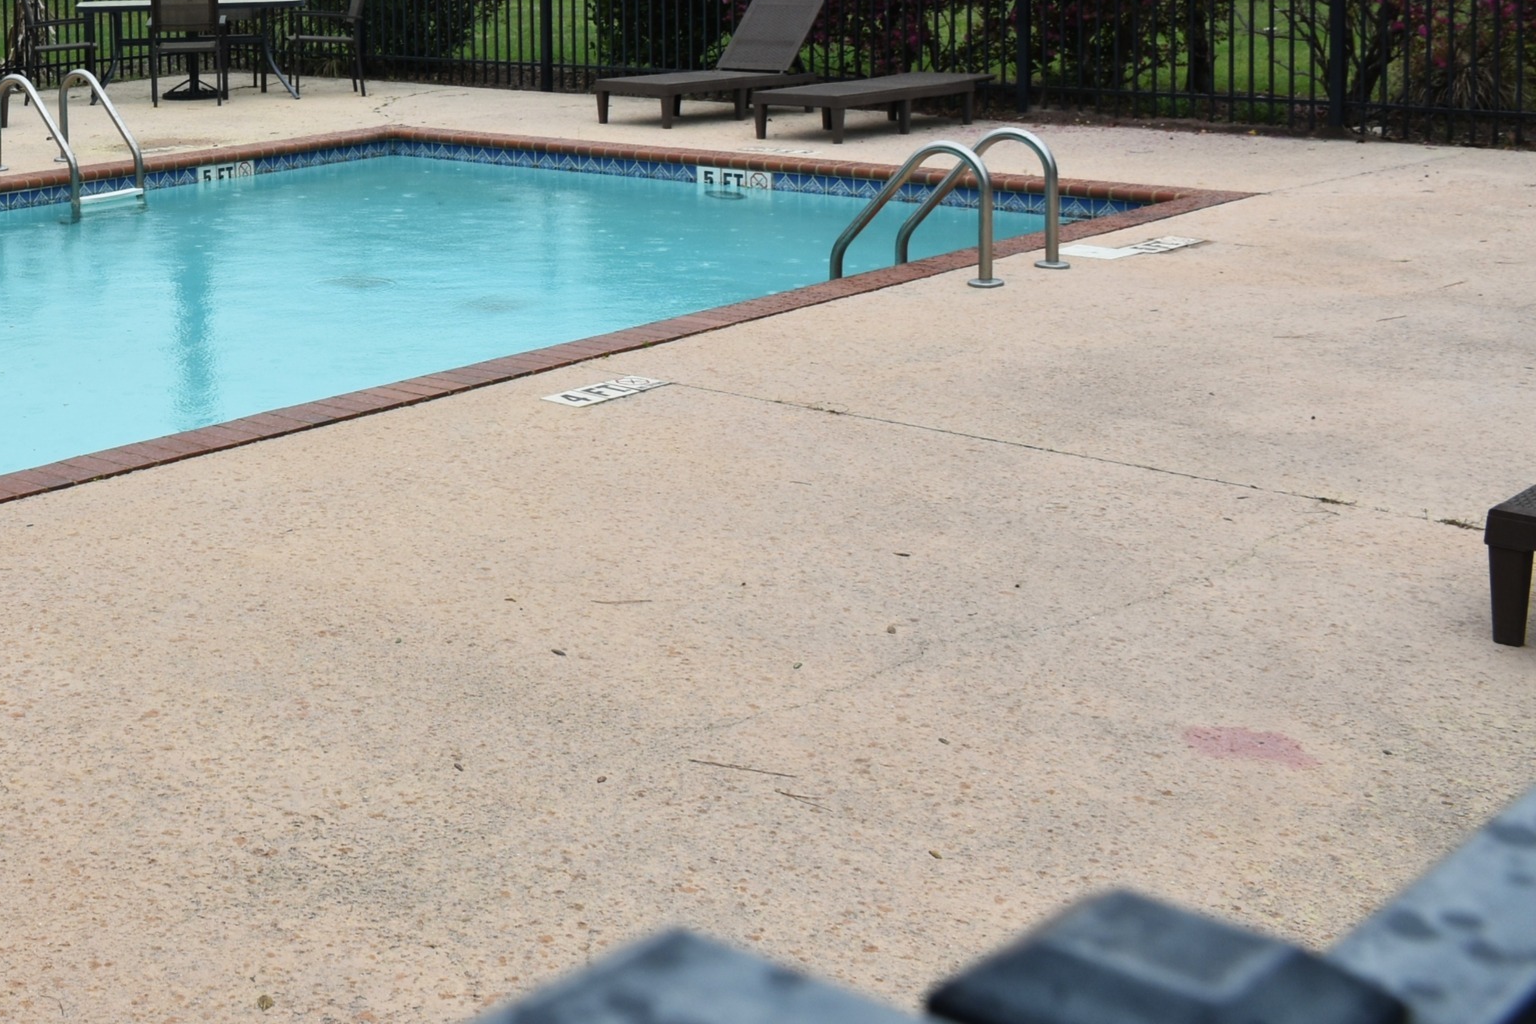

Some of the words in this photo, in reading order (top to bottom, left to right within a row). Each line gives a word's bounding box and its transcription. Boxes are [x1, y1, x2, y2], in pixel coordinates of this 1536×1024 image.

[202, 169, 212, 182] 5
[217, 166, 233, 180] FT
[703, 170, 714, 185] 5
[723, 172, 744, 187] FT
[560, 394, 592, 402] 4
